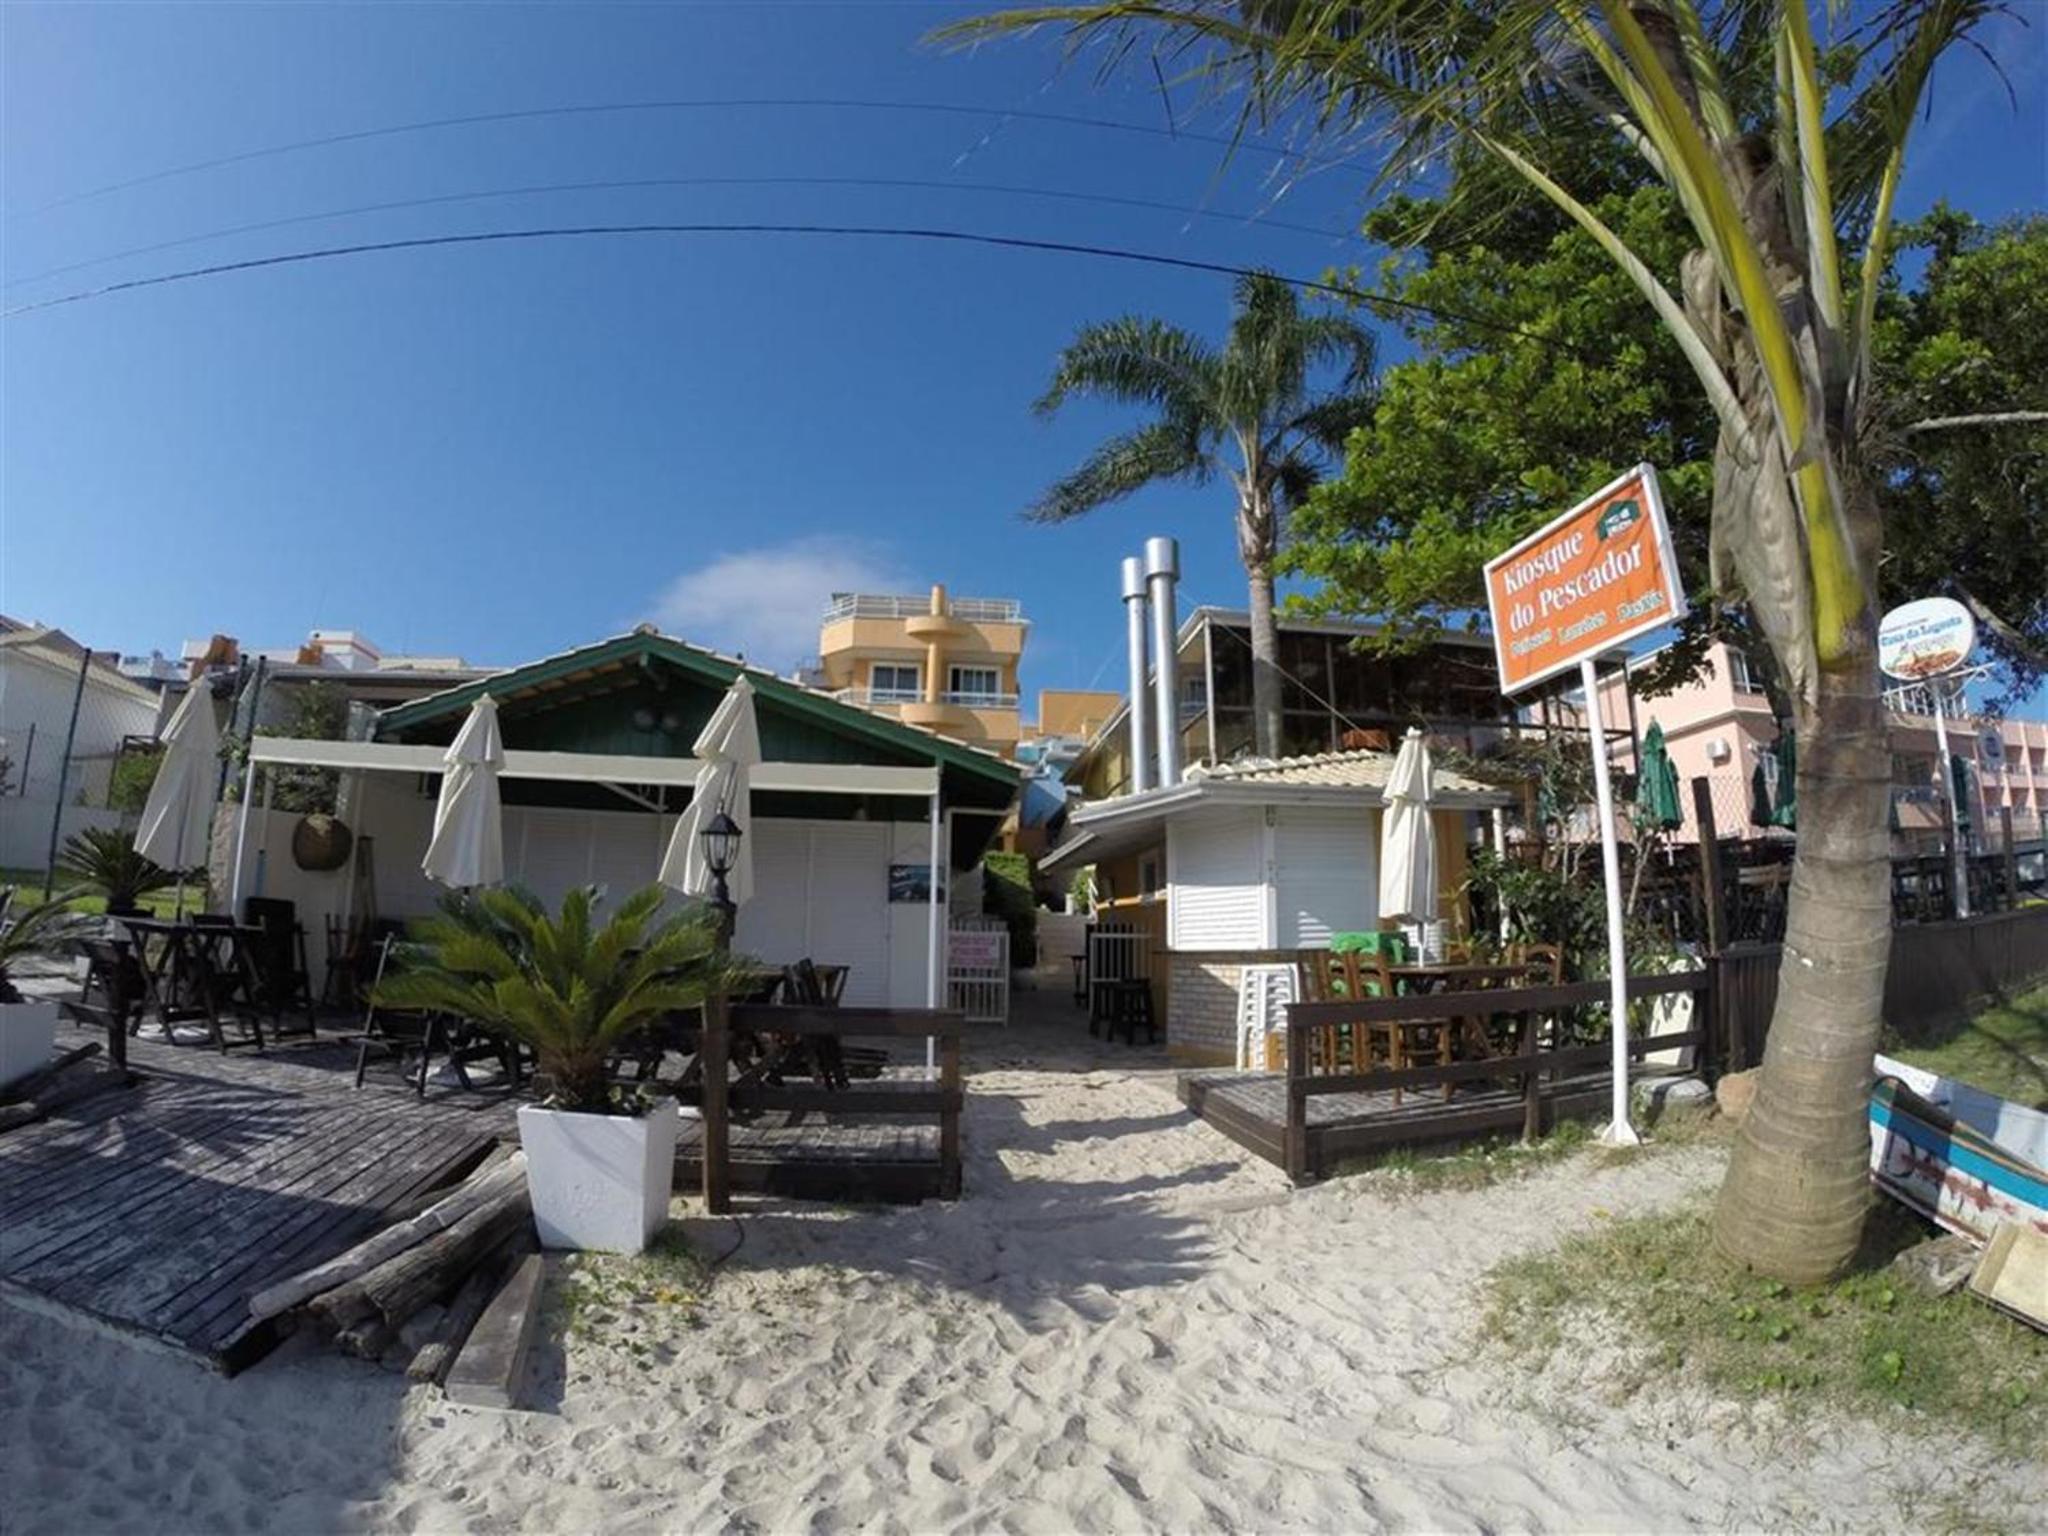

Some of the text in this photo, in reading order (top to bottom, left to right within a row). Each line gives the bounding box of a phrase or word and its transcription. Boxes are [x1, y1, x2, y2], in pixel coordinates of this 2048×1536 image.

[1503, 531, 1584, 595] Kiosque
[1509, 542, 1643, 633] do Pescador
